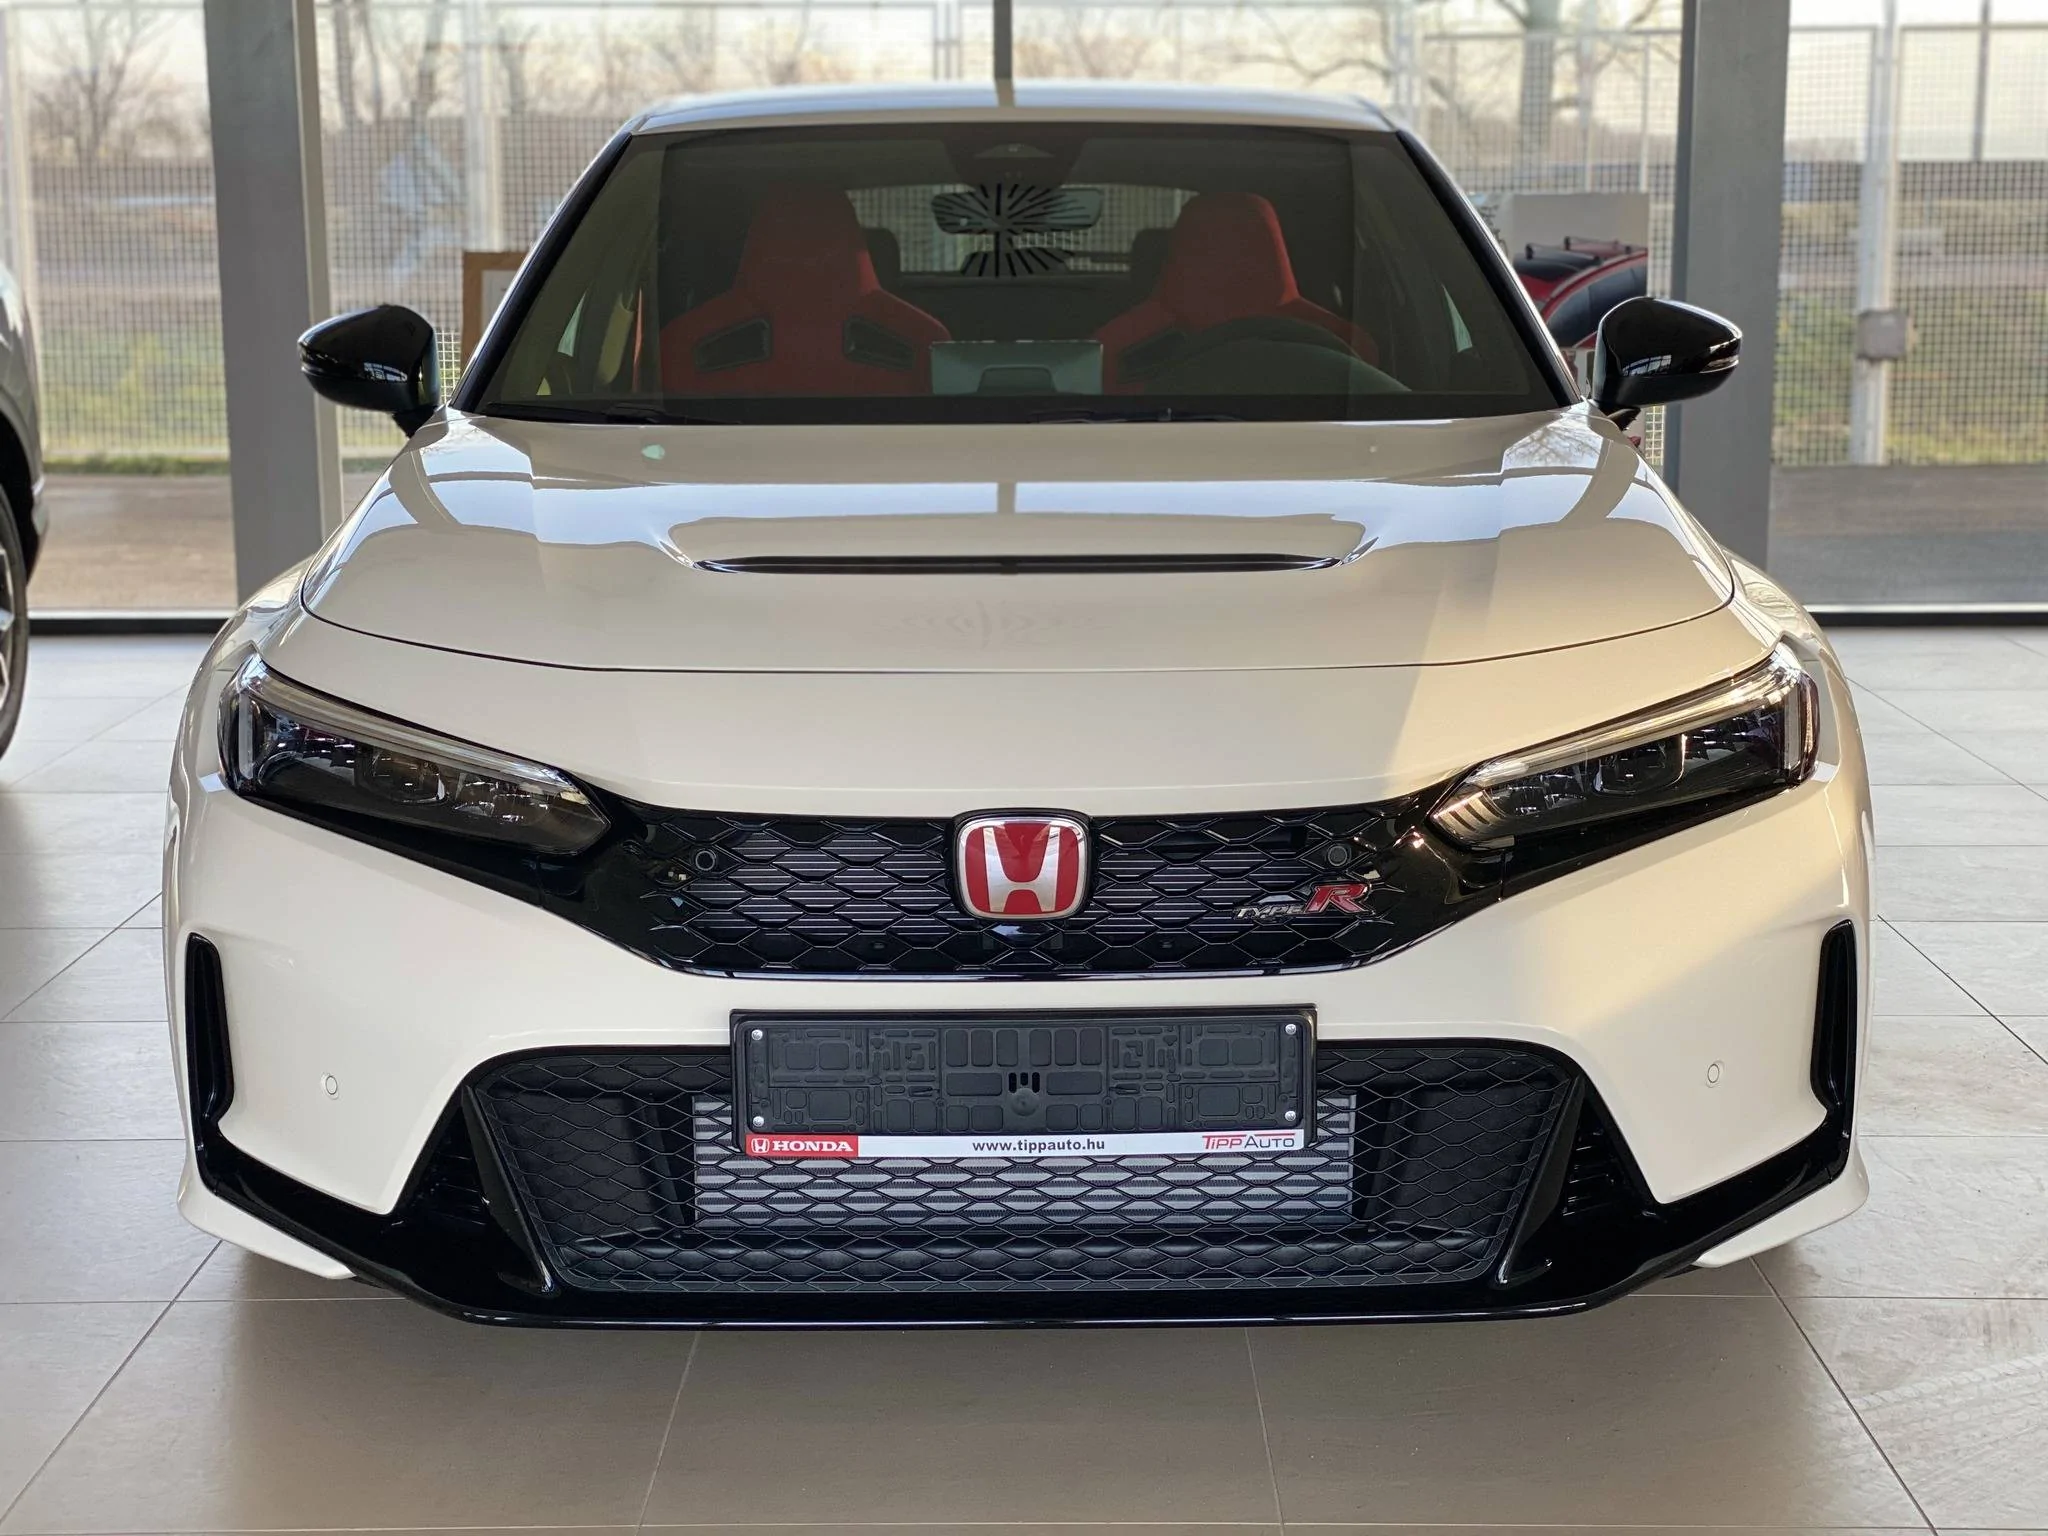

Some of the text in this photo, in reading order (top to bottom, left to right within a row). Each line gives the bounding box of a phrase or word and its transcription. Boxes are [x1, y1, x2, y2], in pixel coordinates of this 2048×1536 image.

[1234, 883, 1374, 920] TYPE R
[773, 1140, 854, 1152] HONDA
[972, 1138, 1105, 1153] www.tippauto.hu
